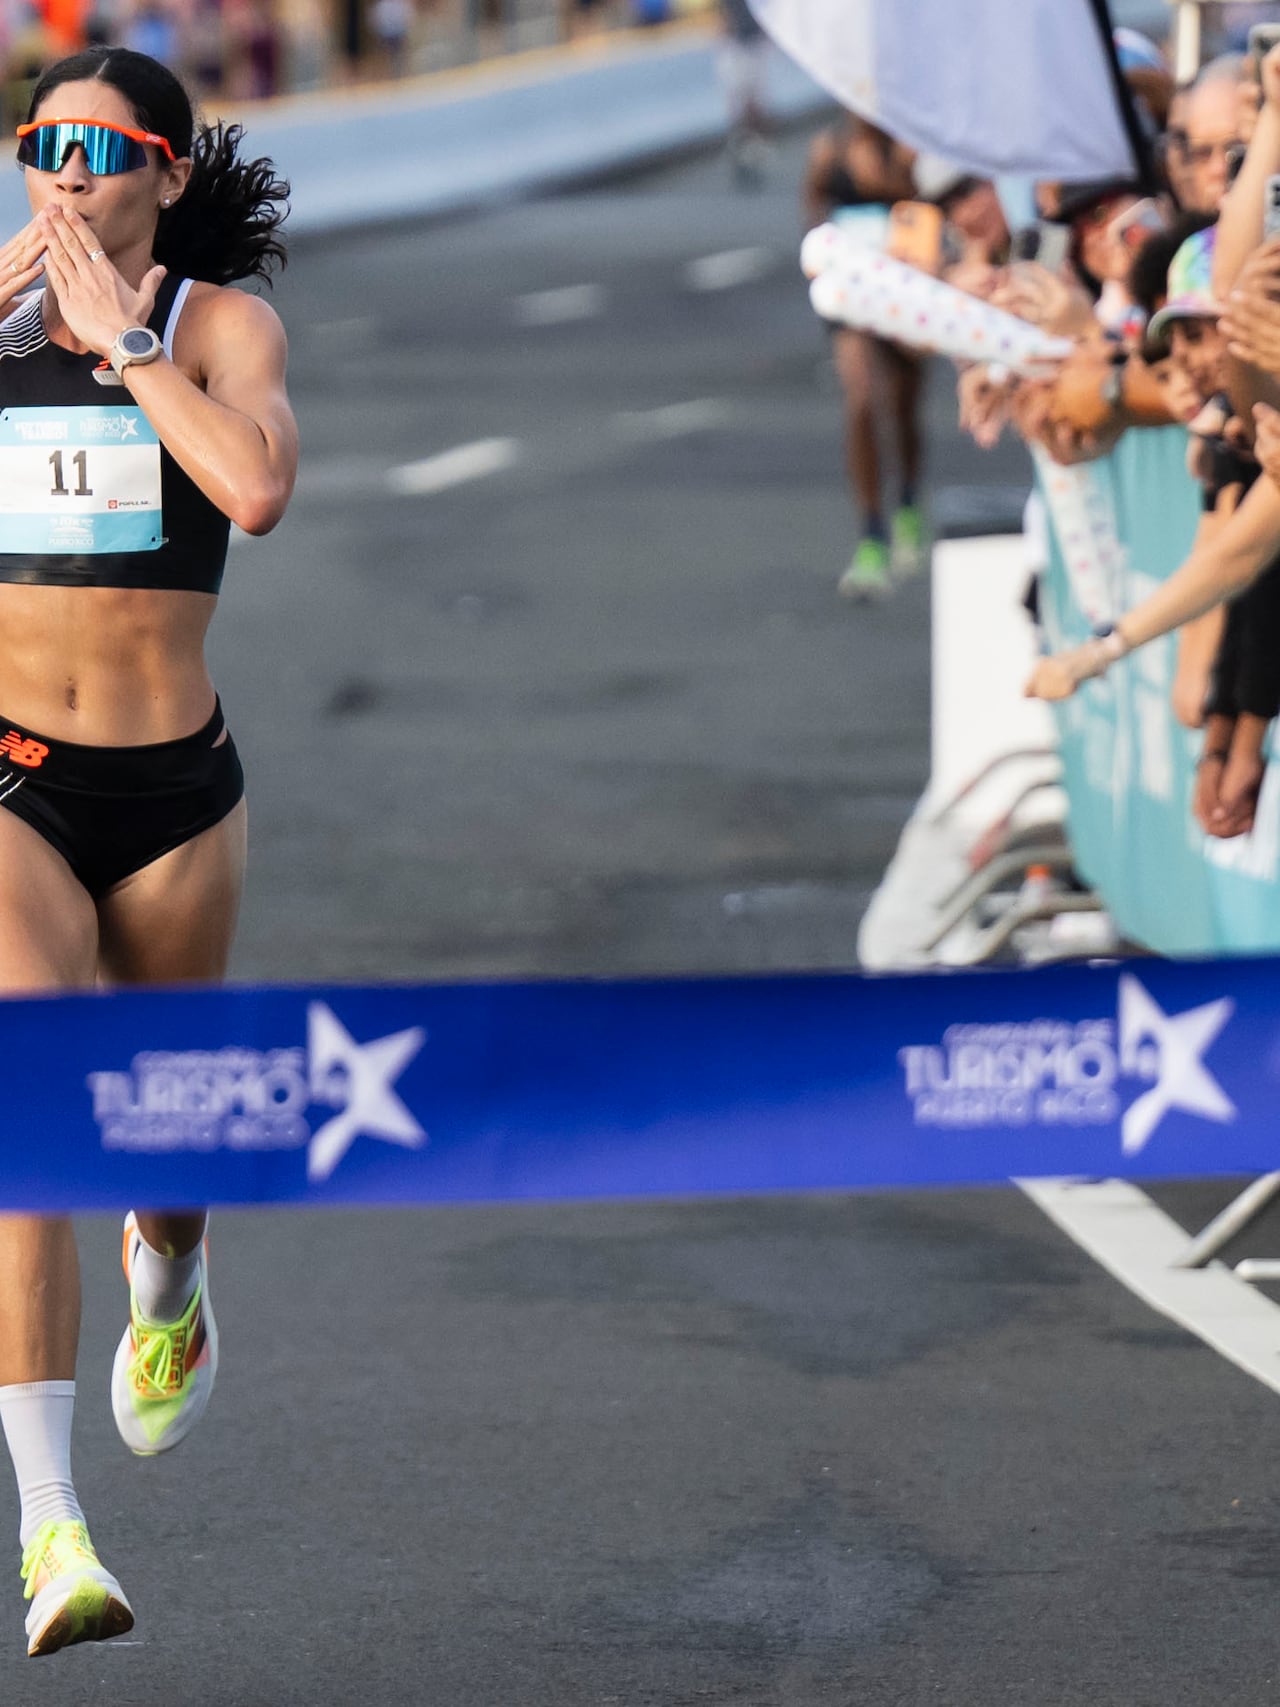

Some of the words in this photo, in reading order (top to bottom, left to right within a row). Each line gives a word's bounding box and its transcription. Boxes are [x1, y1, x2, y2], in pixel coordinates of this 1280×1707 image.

[48, 449, 94, 496] 11
[898, 1042, 1117, 1091] TURISMO
[87, 1069, 308, 1117] TURISMO
